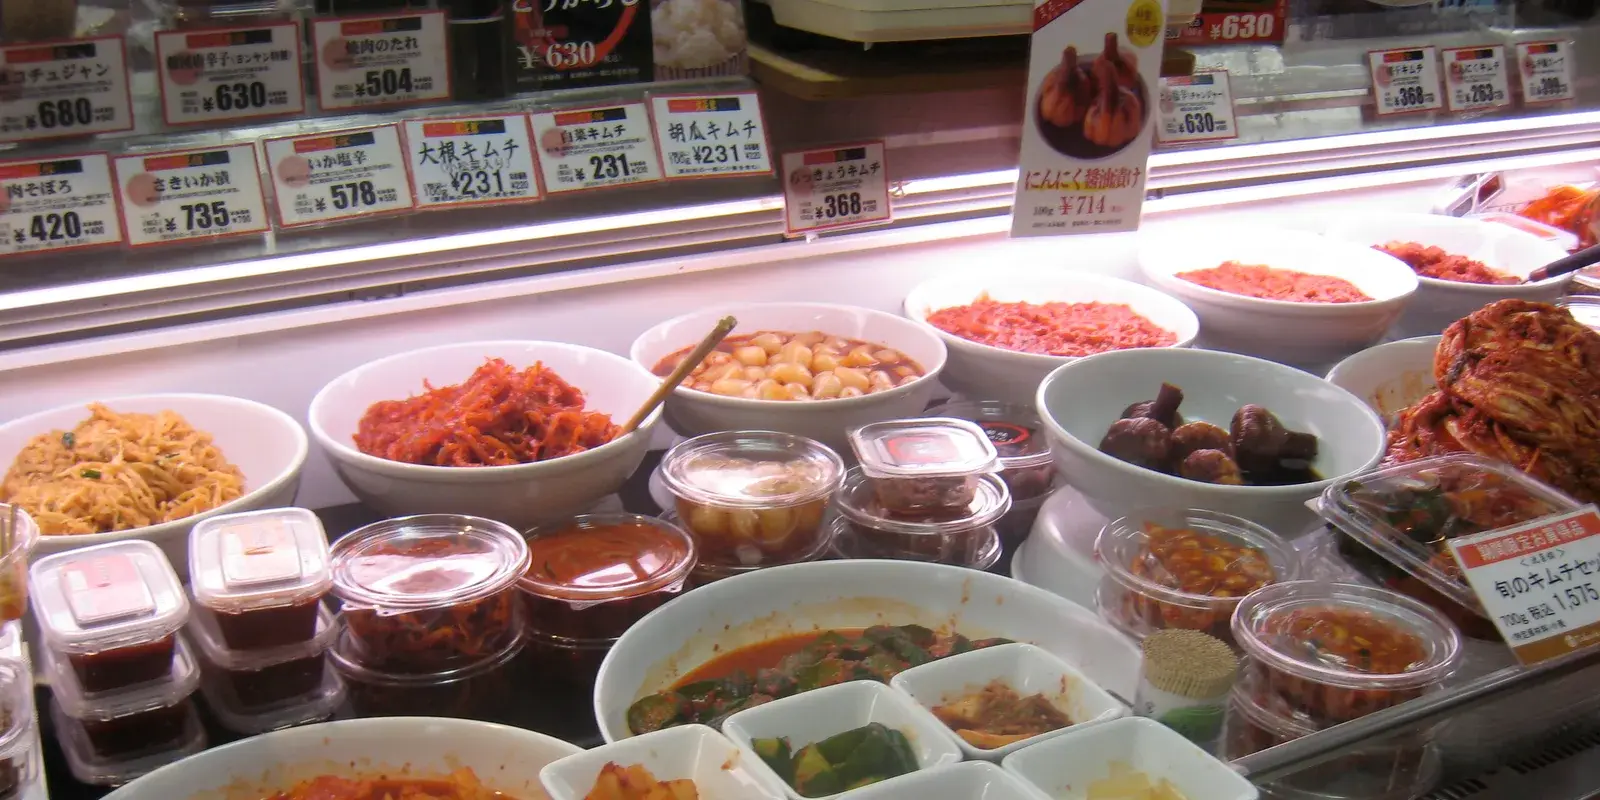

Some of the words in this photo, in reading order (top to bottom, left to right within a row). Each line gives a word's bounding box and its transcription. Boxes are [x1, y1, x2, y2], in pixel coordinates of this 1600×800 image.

[1210, 13, 1275, 40] ¥630
[517, 41, 596, 69] ¥630
[203, 81, 266, 112] ¥630
[355, 68, 413, 98] ¥504
[1394, 86, 1424, 107] ¥368
[26, 98, 92, 131] ¥680
[1179, 112, 1214, 134] ¥630
[561, 124, 626, 144] 白菜キムチ
[668, 120, 757, 143] 胡瓜キムチ
[307, 150, 367, 170] いか塩辛
[418, 138, 520, 165] 大根キムチ
[692, 144, 740, 164] ¥231
[575, 153, 630, 181] ¥231
[449, 169, 504, 195] ¥231
[315, 180, 377, 213] ¥578
[815, 192, 861, 219] ¥368
[1059, 195, 1106, 216] ¥714
[14, 211, 82, 244] ¥420
[165, 201, 230, 233] ¥735
[1500, 611, 1529, 626] 700g
[1553, 582, 1600, 611] 1,575
